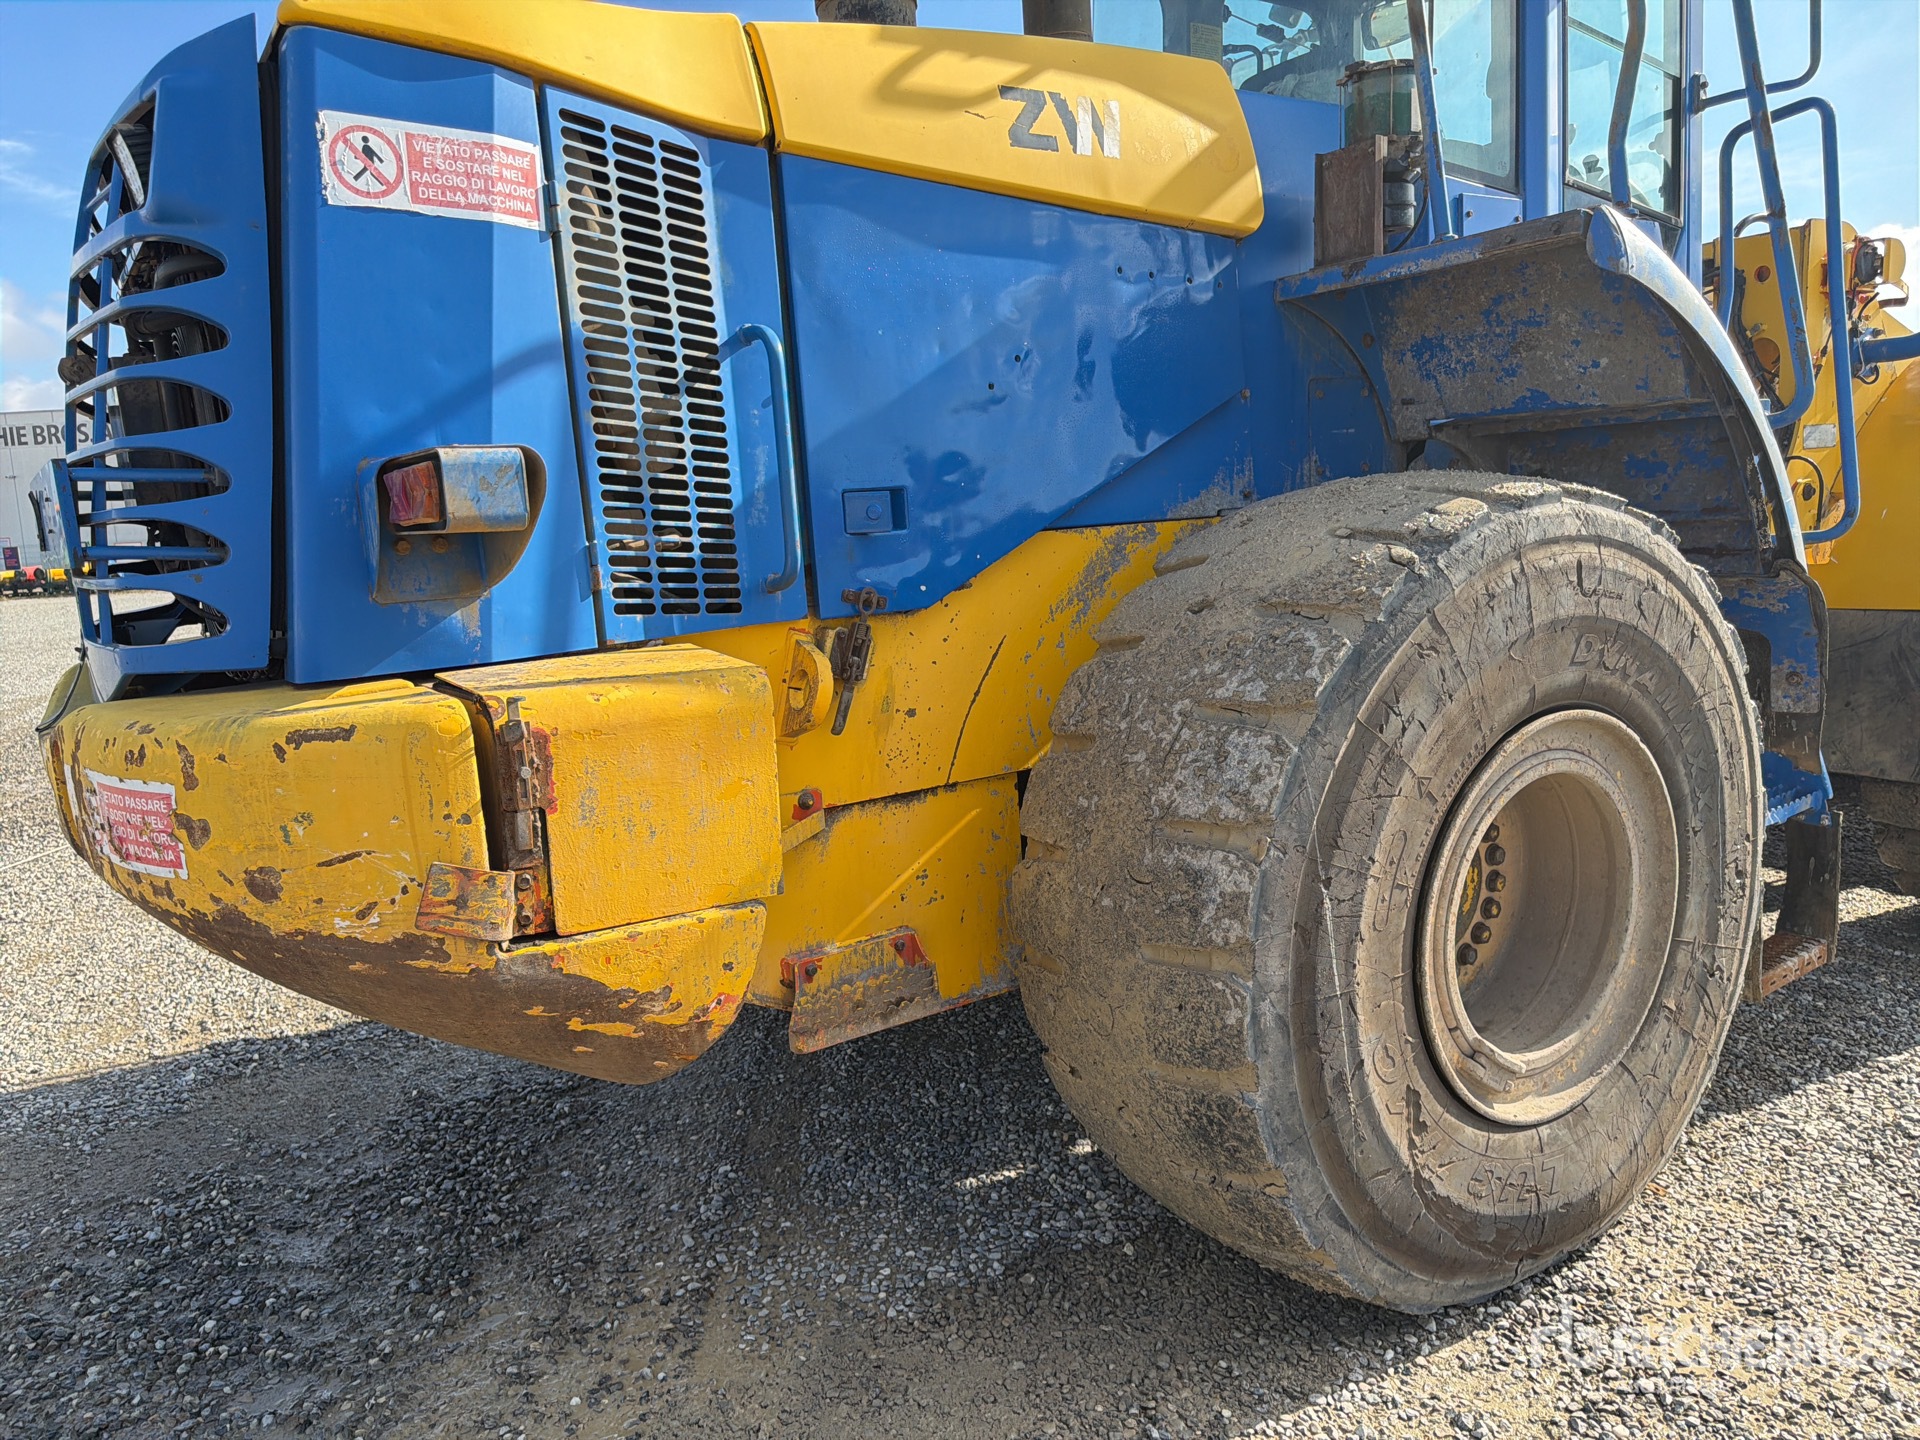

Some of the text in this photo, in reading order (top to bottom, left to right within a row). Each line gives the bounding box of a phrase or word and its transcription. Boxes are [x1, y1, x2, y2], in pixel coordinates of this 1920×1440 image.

[412, 139, 531, 169] VIETATO PASSARE
[423, 157, 526, 183] E SOSTARE NEL
[411, 171, 536, 200] RAGGIO DI LAVORO
[418, 187, 534, 214] DELLA MACCHINA
[109, 808, 144, 827] SOSTARE
[125, 795, 168, 814] PASSARE
[128, 830, 136, 842] DI
